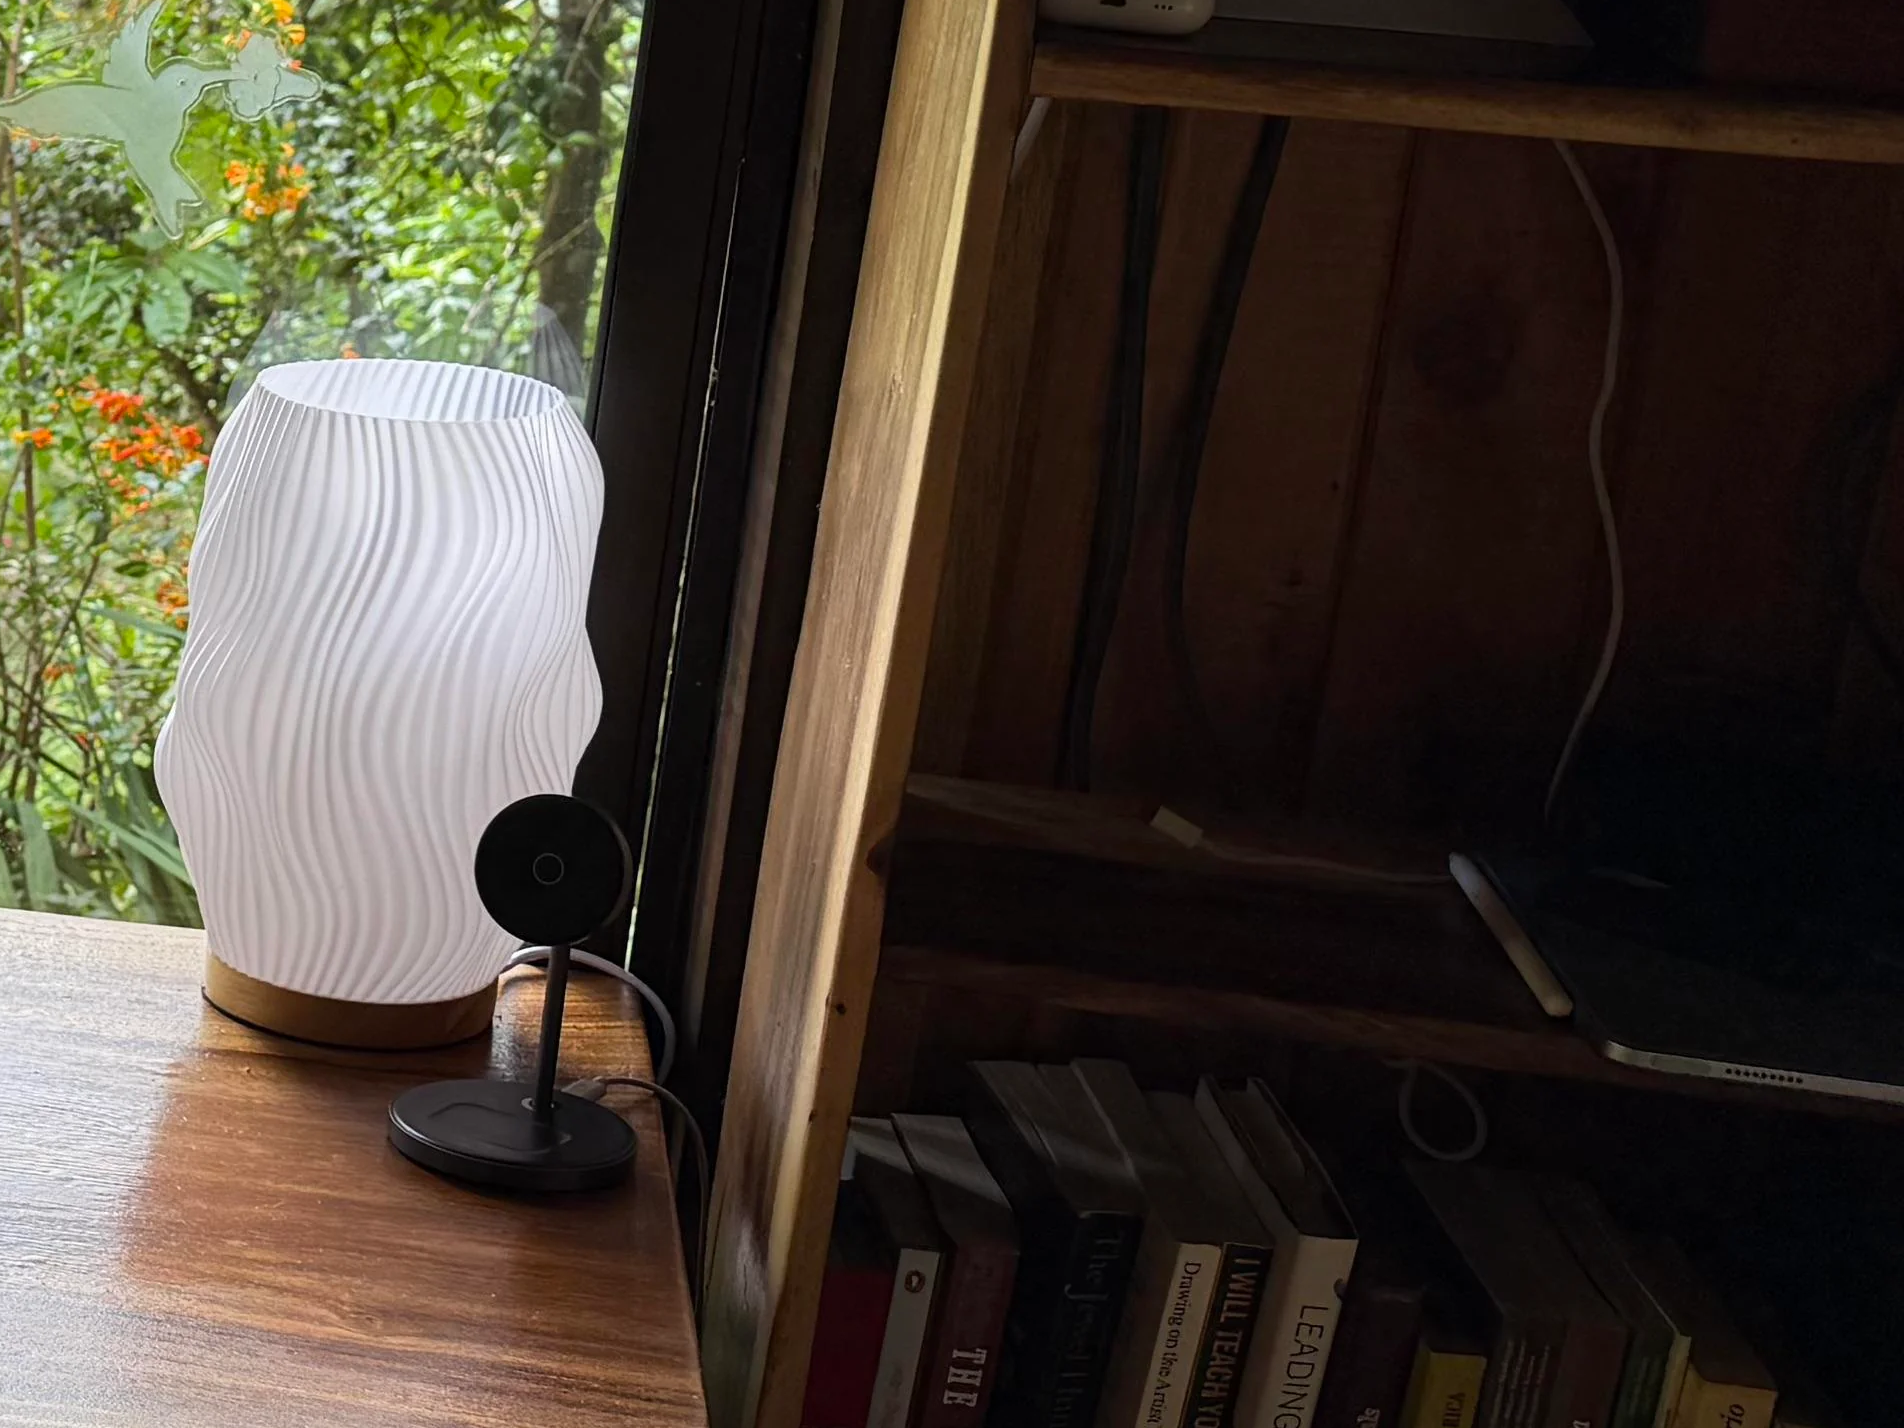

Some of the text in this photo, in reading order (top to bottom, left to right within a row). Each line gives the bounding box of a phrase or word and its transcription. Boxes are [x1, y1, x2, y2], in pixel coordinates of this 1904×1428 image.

[1167, 1261, 1202, 1327] Drawing
[1220, 1270, 1260, 1324] WILL
[1165, 1328, 1181, 1349] on
[1200, 1329, 1243, 1400] TEACH
[942, 1347, 989, 1408] THE
[1442, 1392, 1466, 1428] RICA
